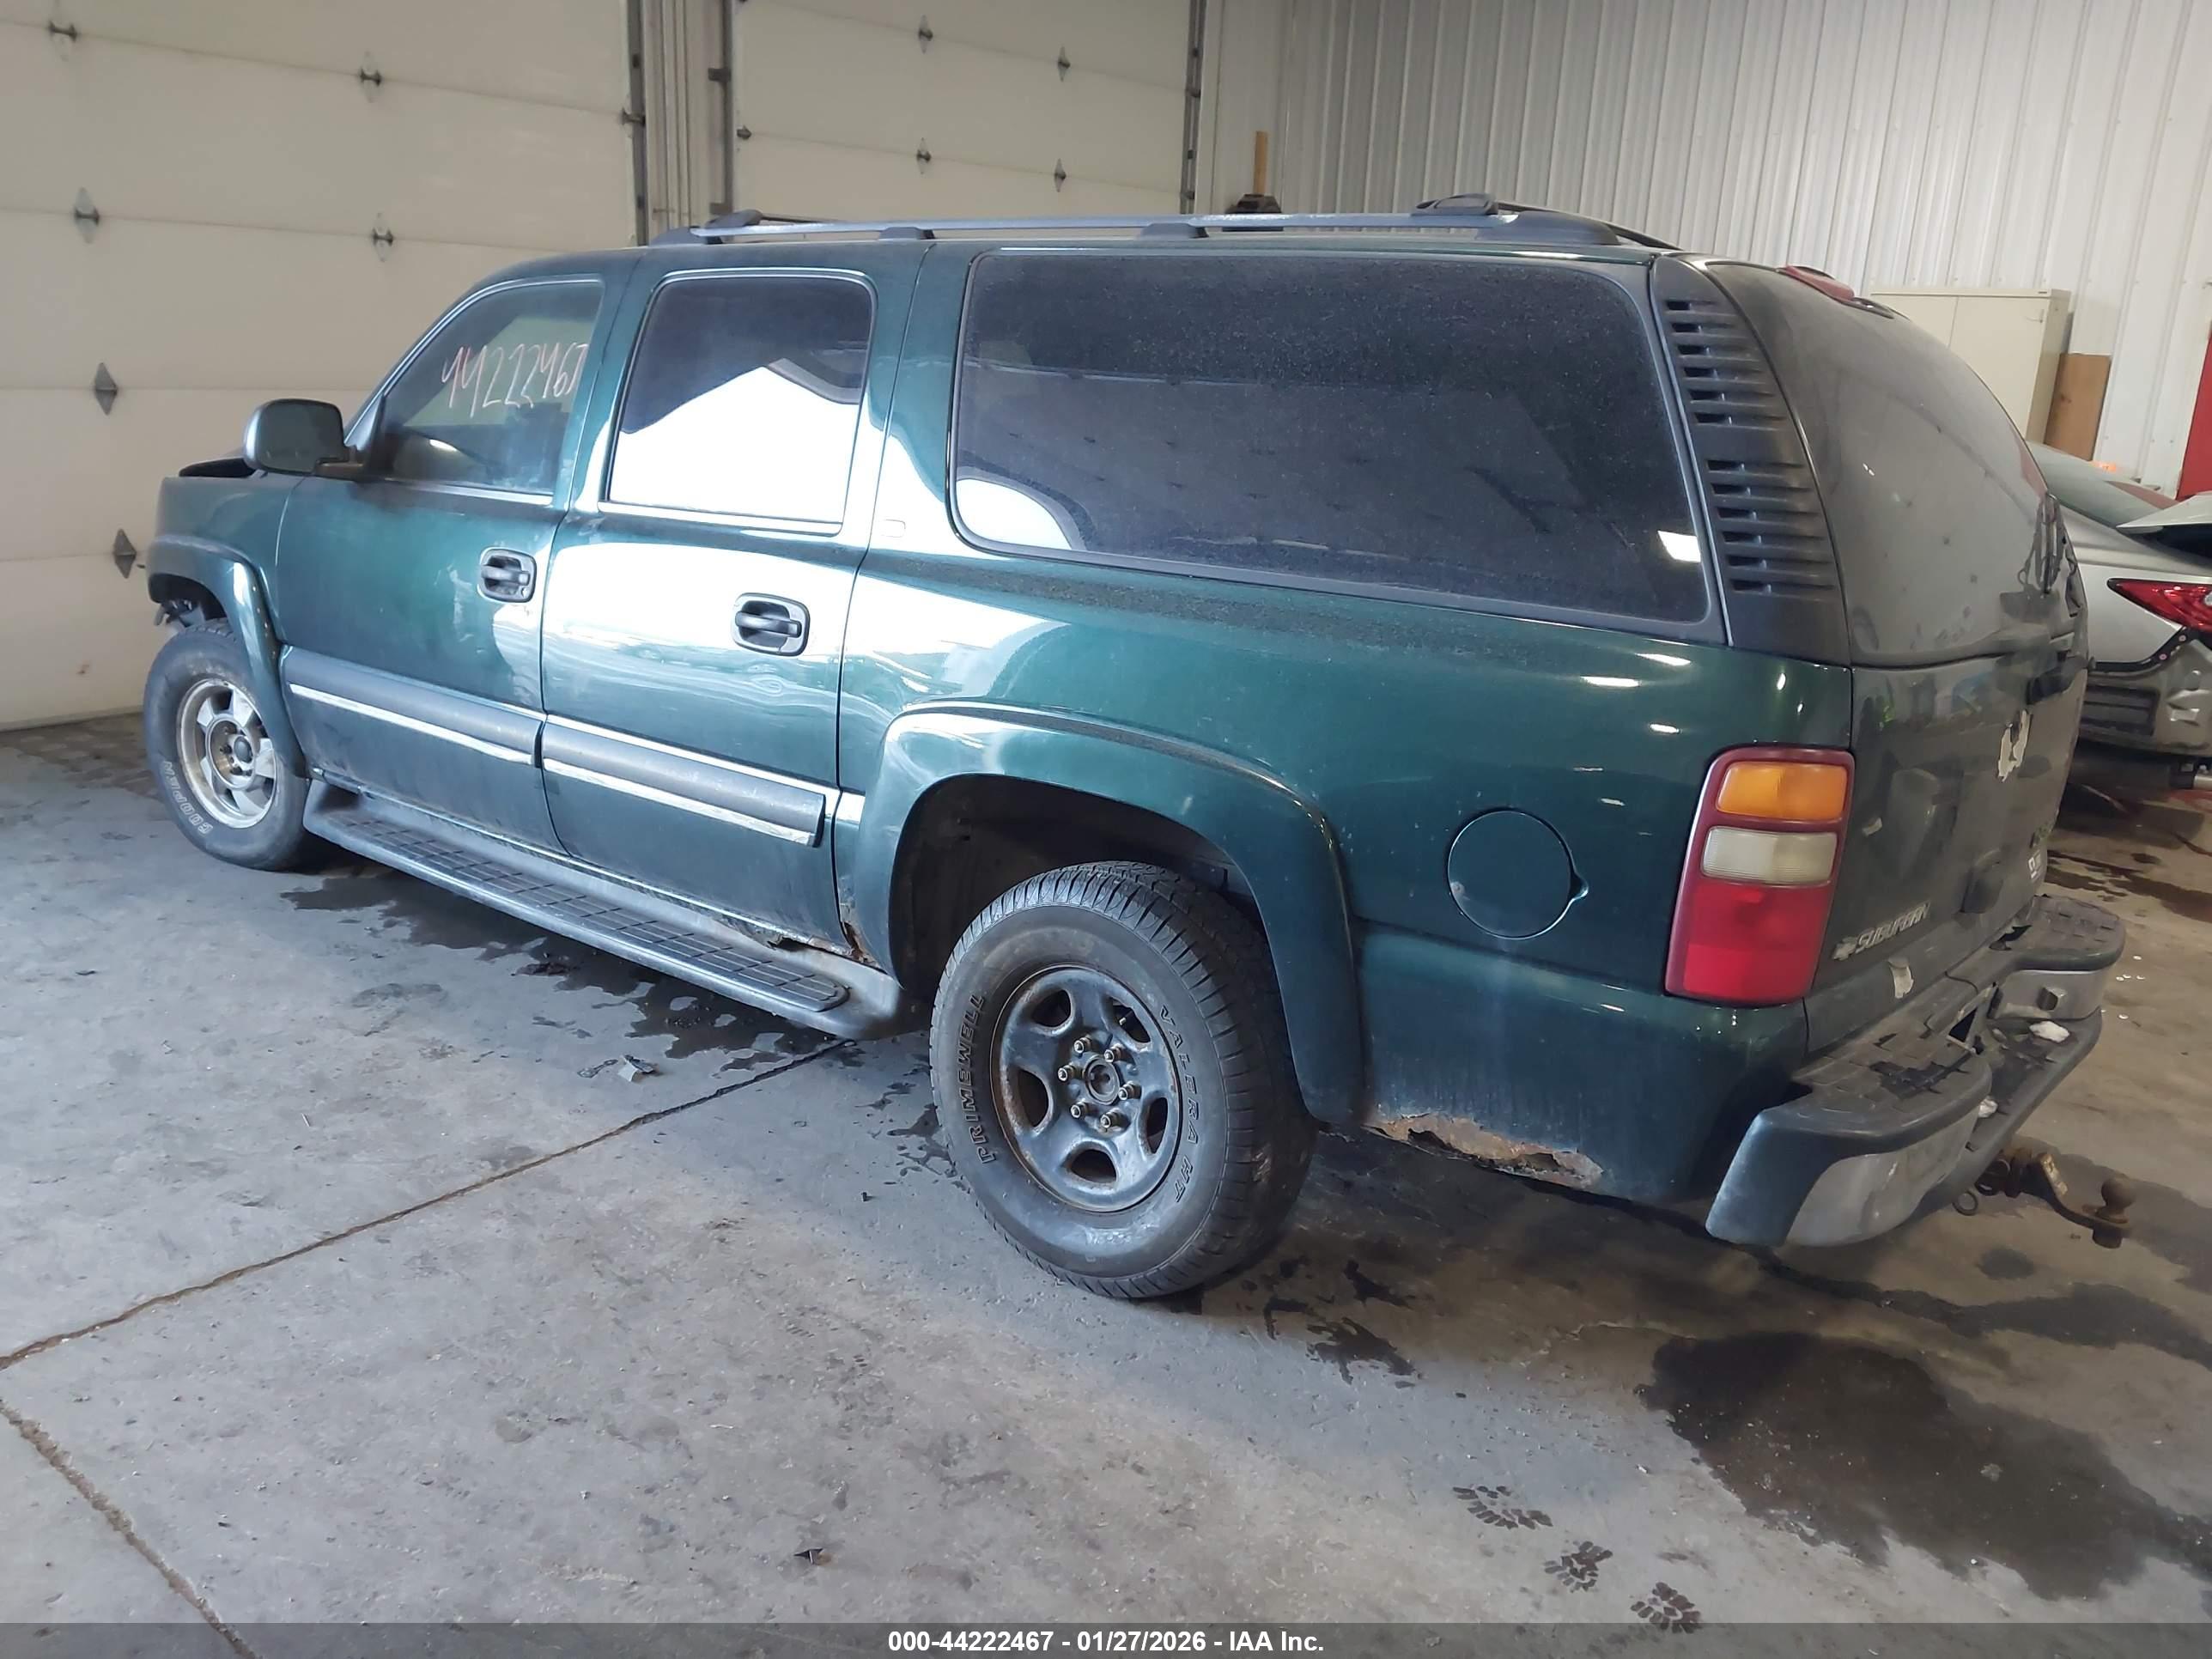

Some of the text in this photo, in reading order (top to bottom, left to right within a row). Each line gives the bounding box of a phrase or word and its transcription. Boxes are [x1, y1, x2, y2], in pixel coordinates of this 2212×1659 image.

[441, 342, 590, 418] 44222467
[956, 994, 998, 1164] PRIMEWELL
[1159, 1005, 1199, 1203] VALERA HT
